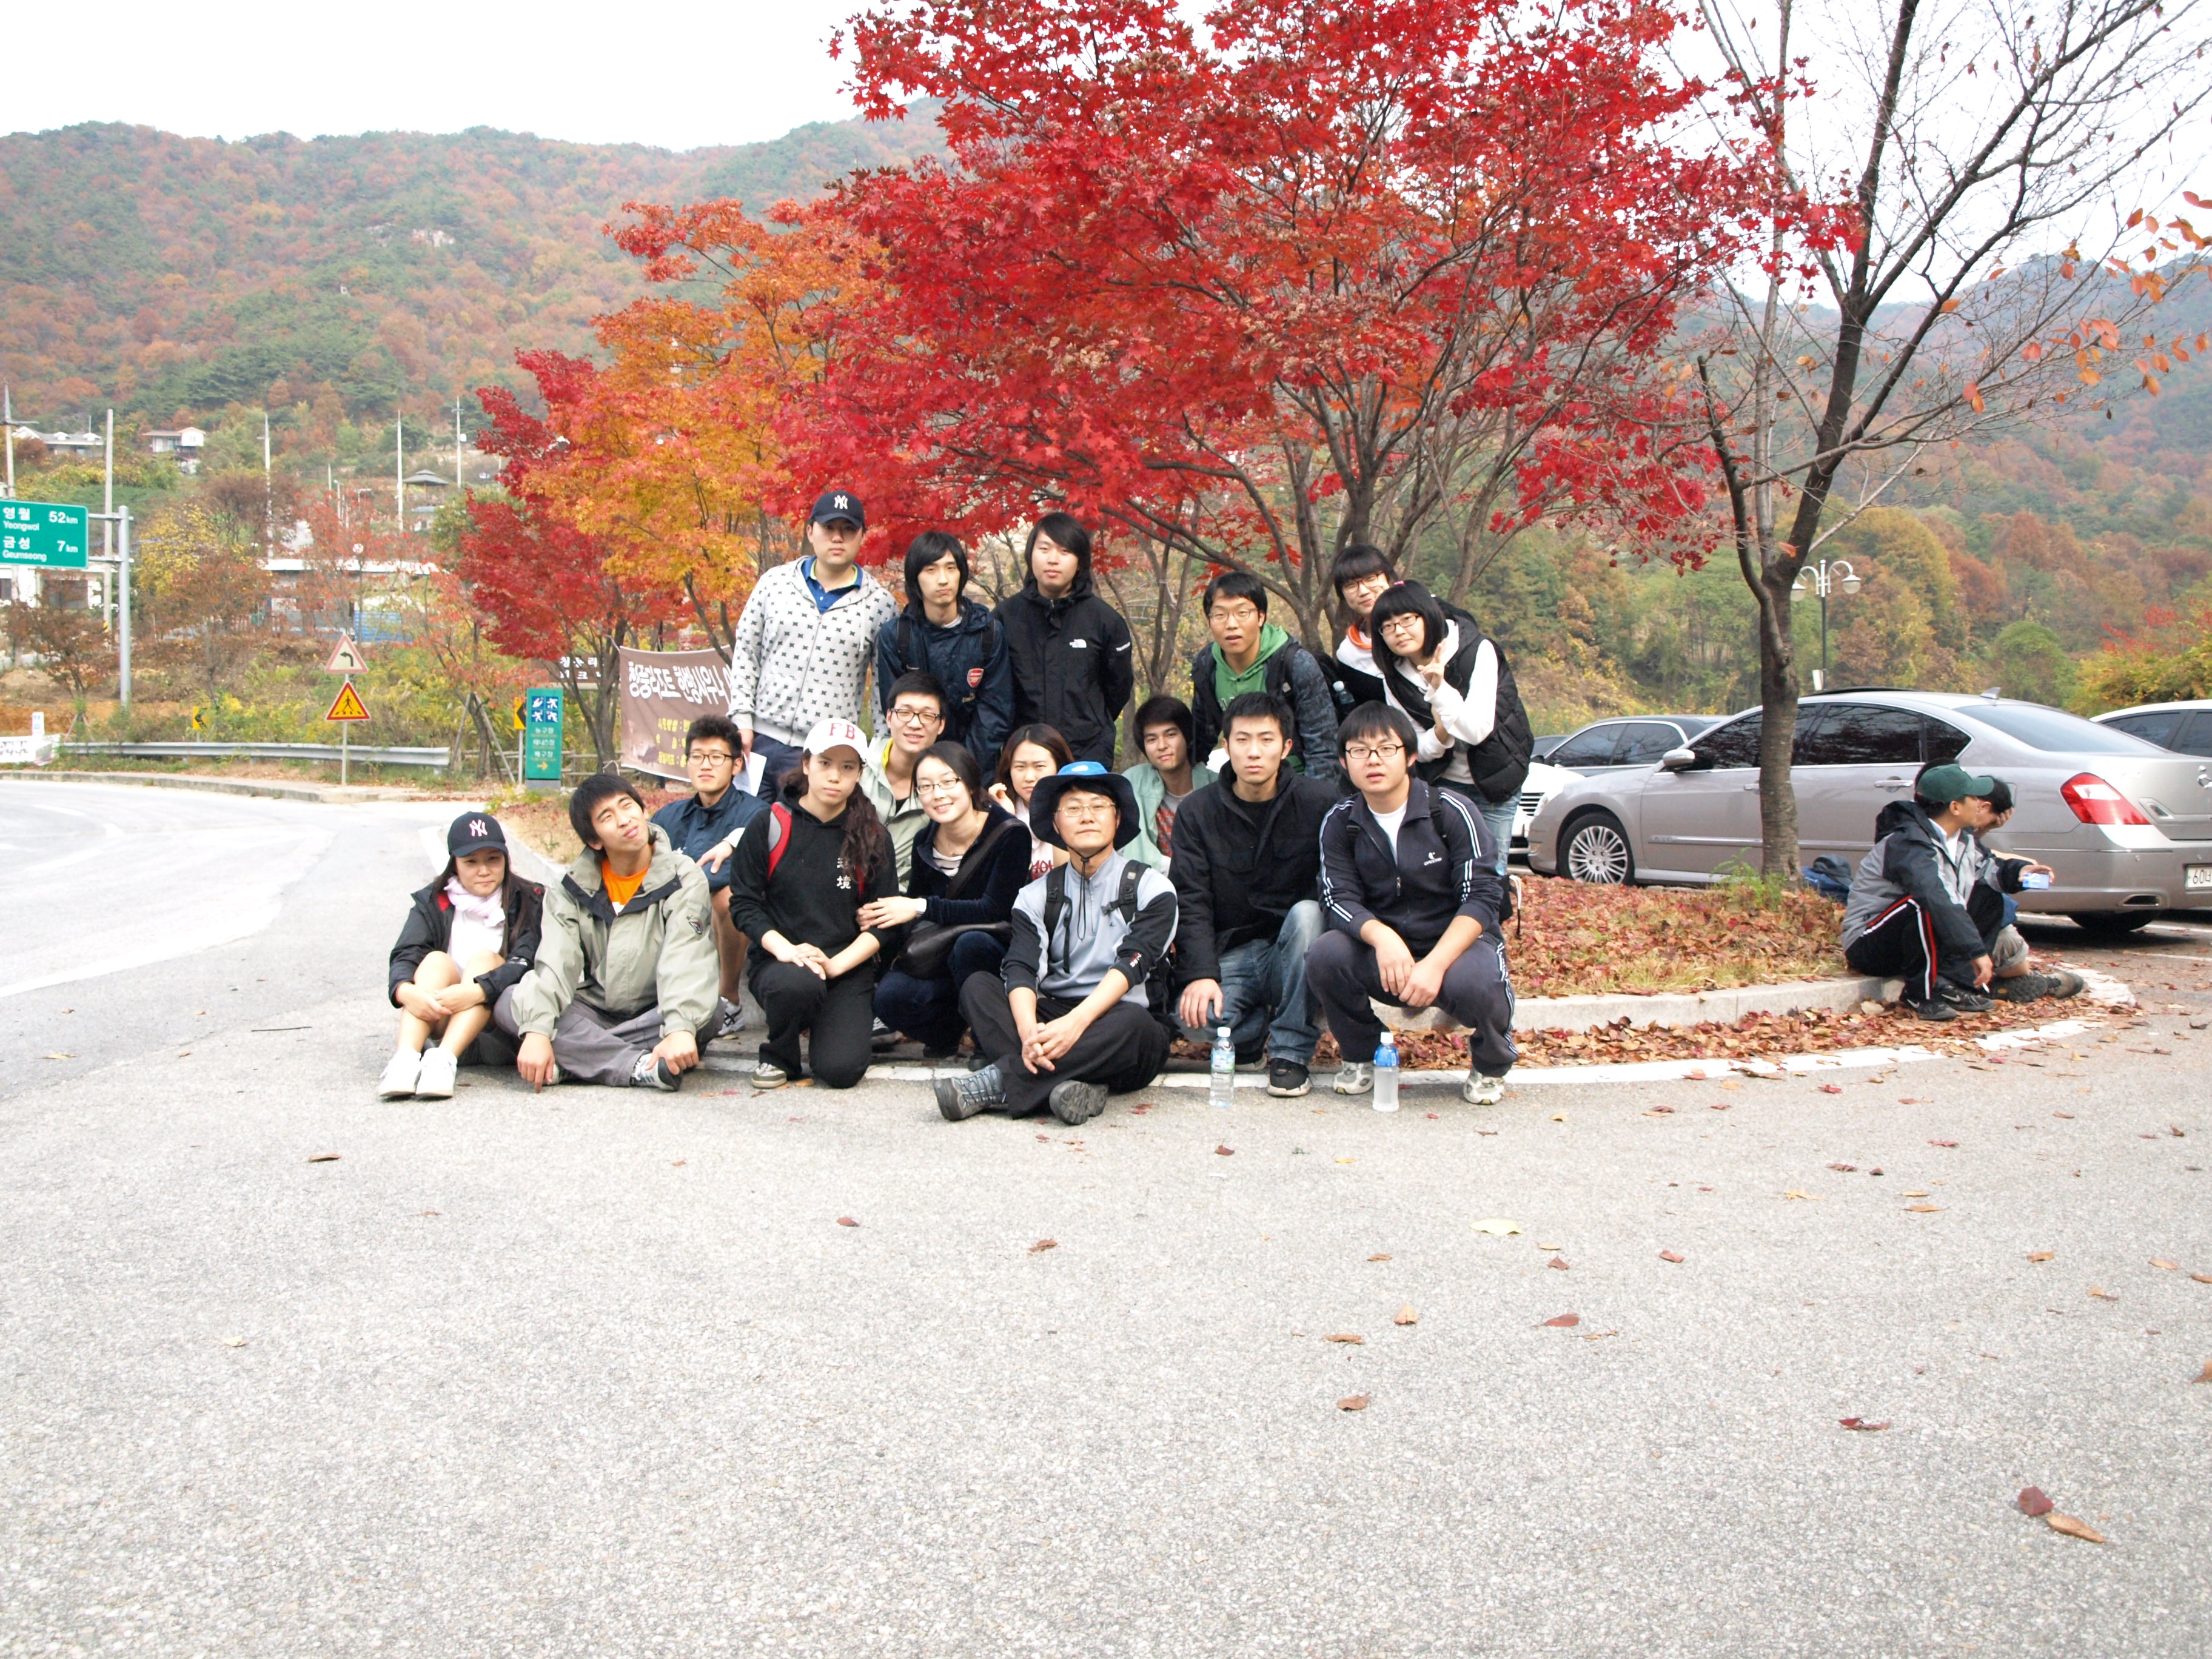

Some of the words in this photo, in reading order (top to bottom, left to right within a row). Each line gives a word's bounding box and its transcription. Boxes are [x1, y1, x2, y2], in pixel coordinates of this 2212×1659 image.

[3, 507, 30, 521] 영월
[3, 520, 40, 532] Yeongwol
[3, 536, 30, 550] 금성
[2, 549, 47, 562] Geumseong
[469, 819, 488, 837] NY
